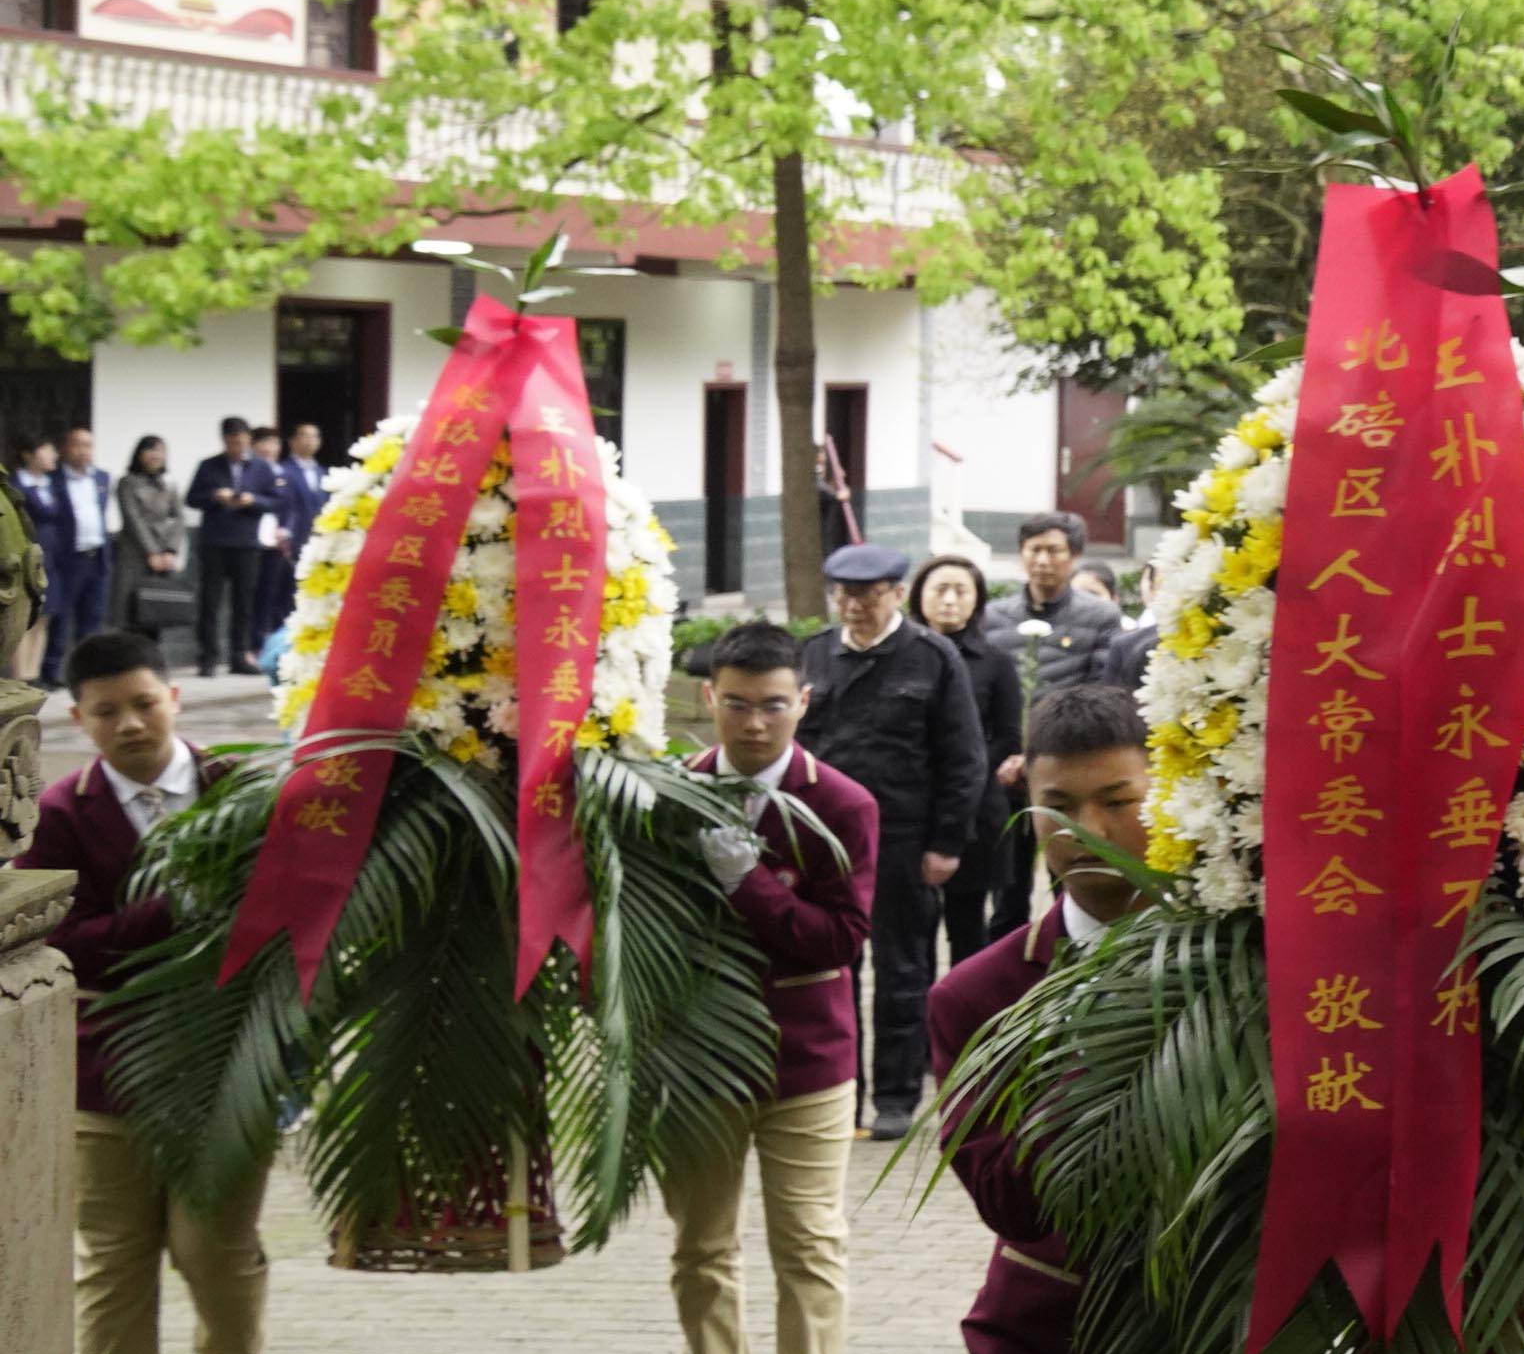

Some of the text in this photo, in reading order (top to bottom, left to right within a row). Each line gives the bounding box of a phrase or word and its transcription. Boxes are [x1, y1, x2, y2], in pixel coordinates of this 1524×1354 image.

[294, 752, 365, 837] 敬献
[532, 405, 592, 820] 王朴烈士永垂不朽
[1297, 318, 1409, 1111] 北碚区人大常委会 敬献
